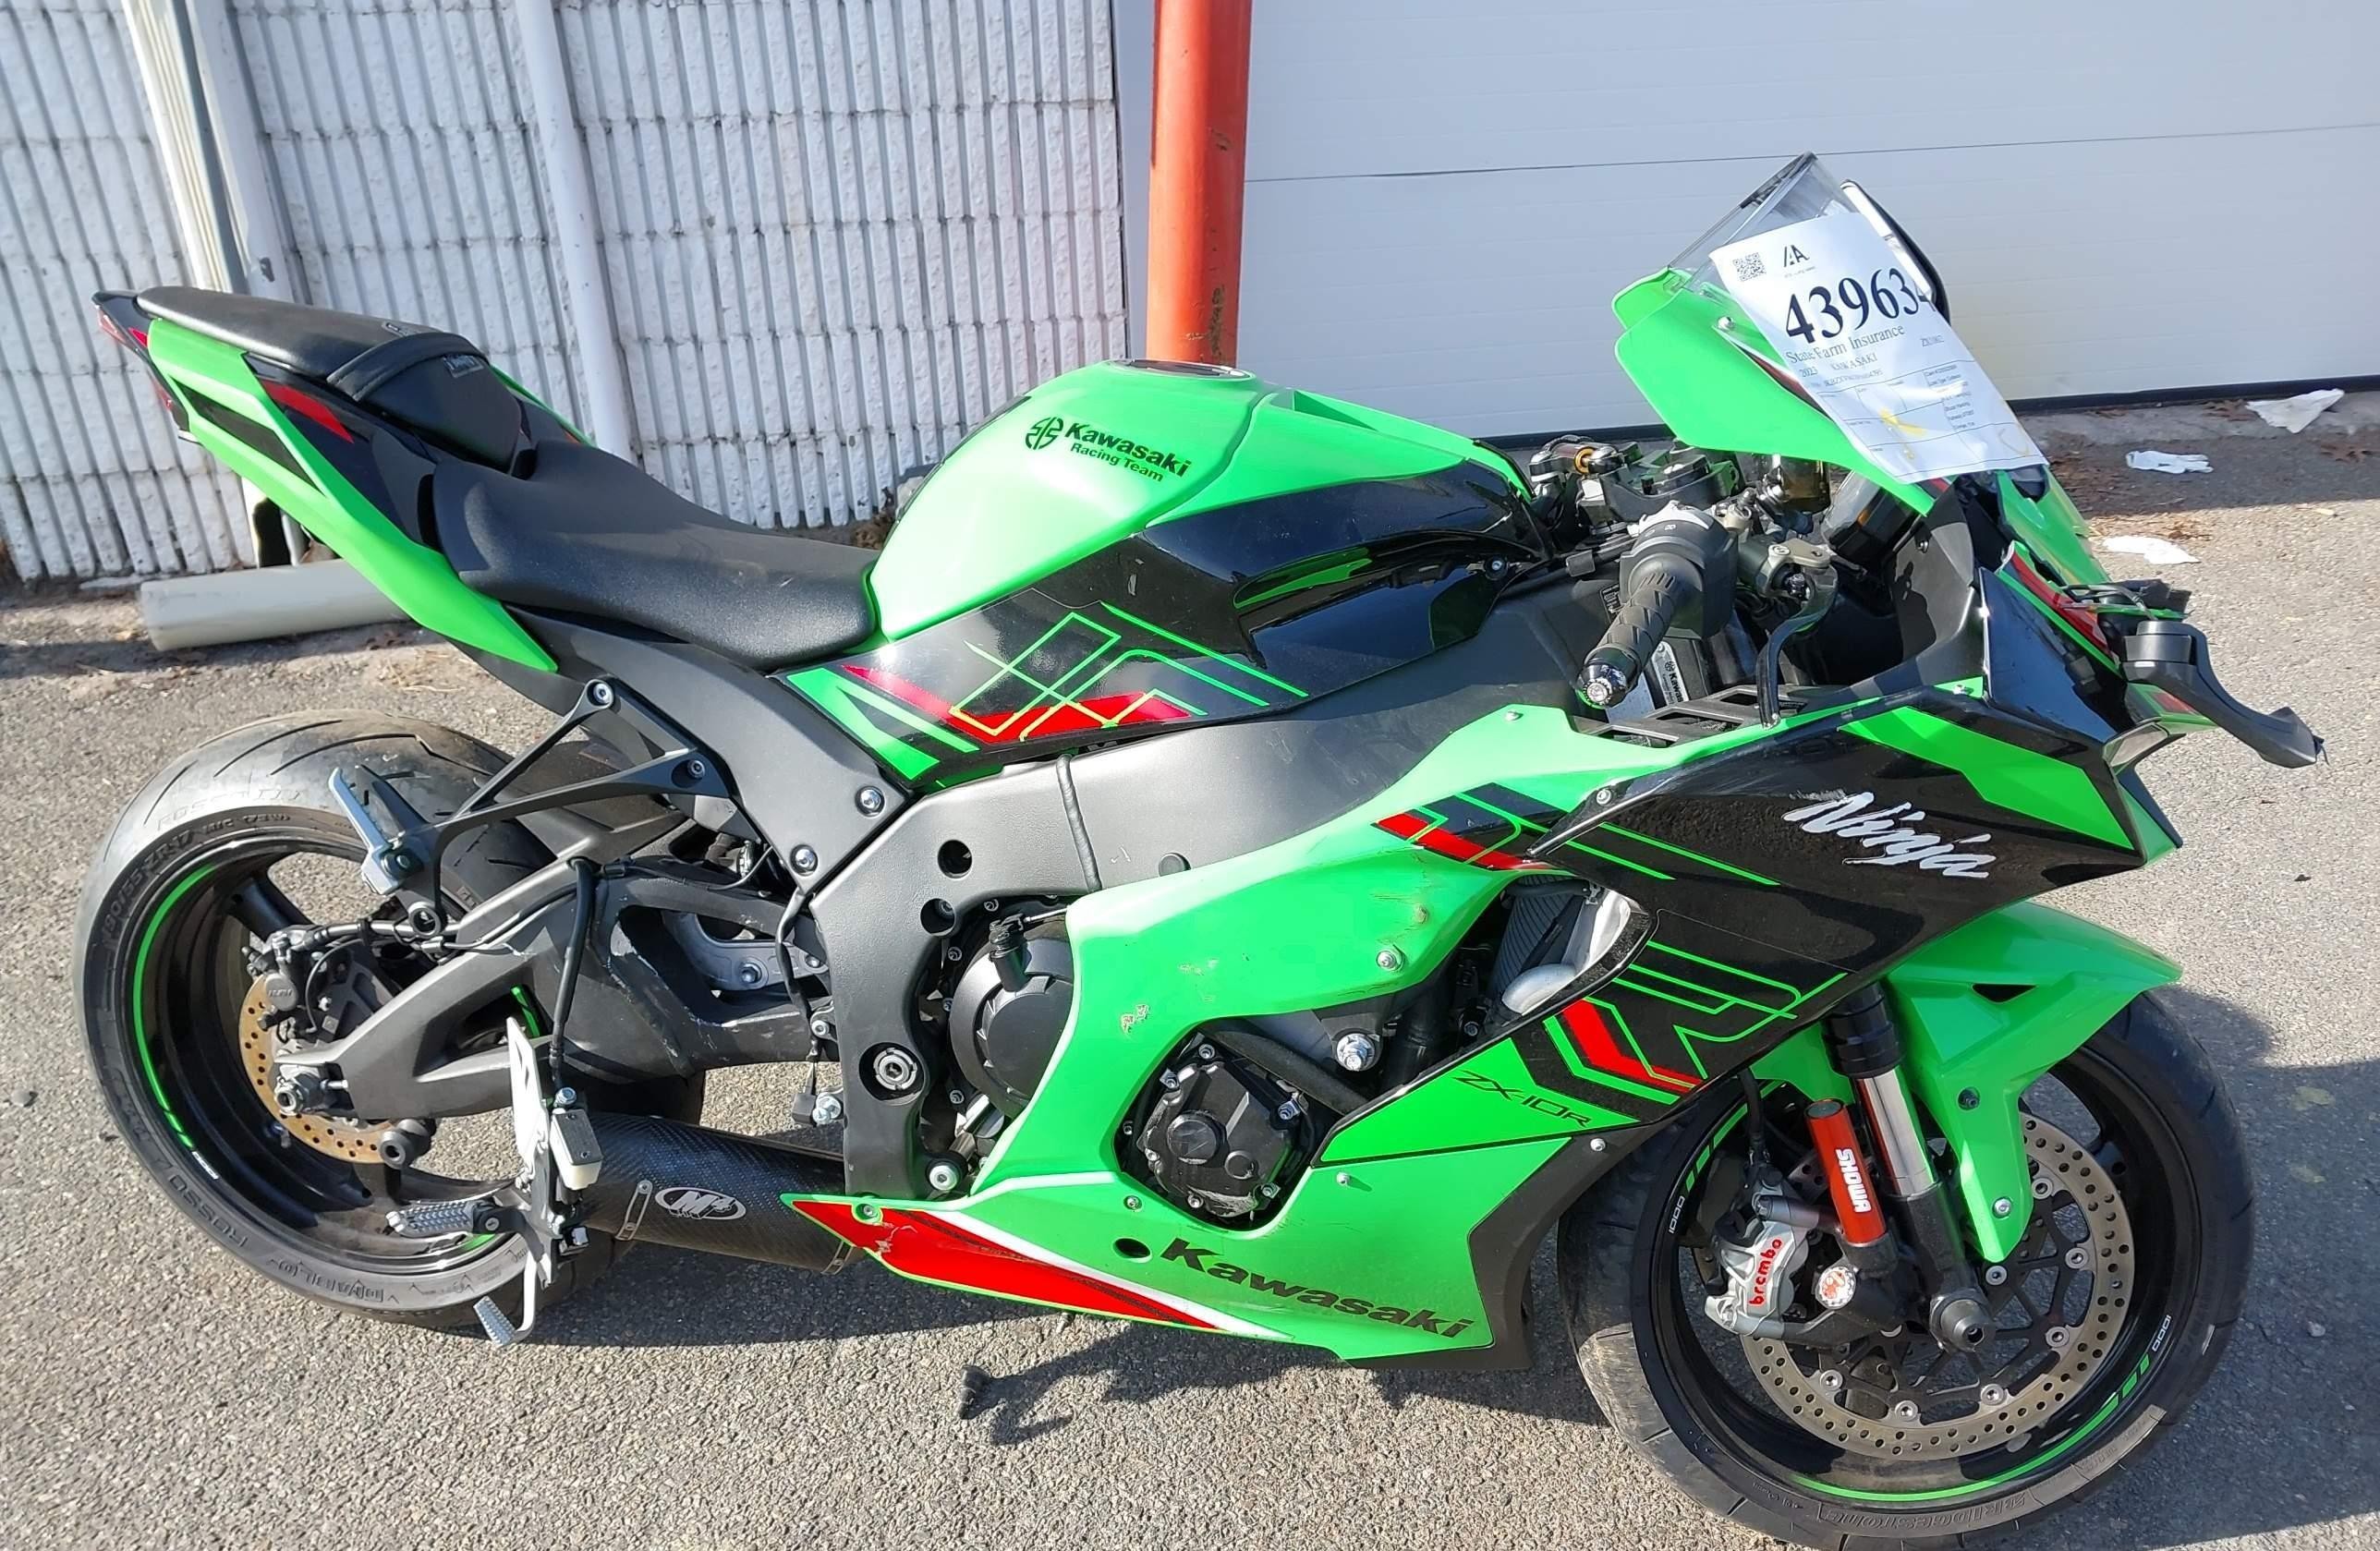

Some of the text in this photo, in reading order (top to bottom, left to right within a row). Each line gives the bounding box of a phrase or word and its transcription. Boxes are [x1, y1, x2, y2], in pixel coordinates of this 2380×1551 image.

[1814, 342, 1848, 361] Farm
[1850, 323, 1905, 349] Insurance
[1064, 422, 1192, 478] Kawasaki
[1070, 442, 1164, 482] Racing Team
[1781, 792, 1997, 878] Ninja
[1452, 1070, 1592, 1128] ZX-10R
[1836, 1148, 1872, 1213] SHOWA
[168, 1173, 249, 1247] ROSSO
[1668, 1195, 1685, 1234] 1000
[1160, 1237, 1475, 1339] Kawasaki
[1749, 1239, 1783, 1306] brembo
[2152, 1315, 2172, 1352] 1000
